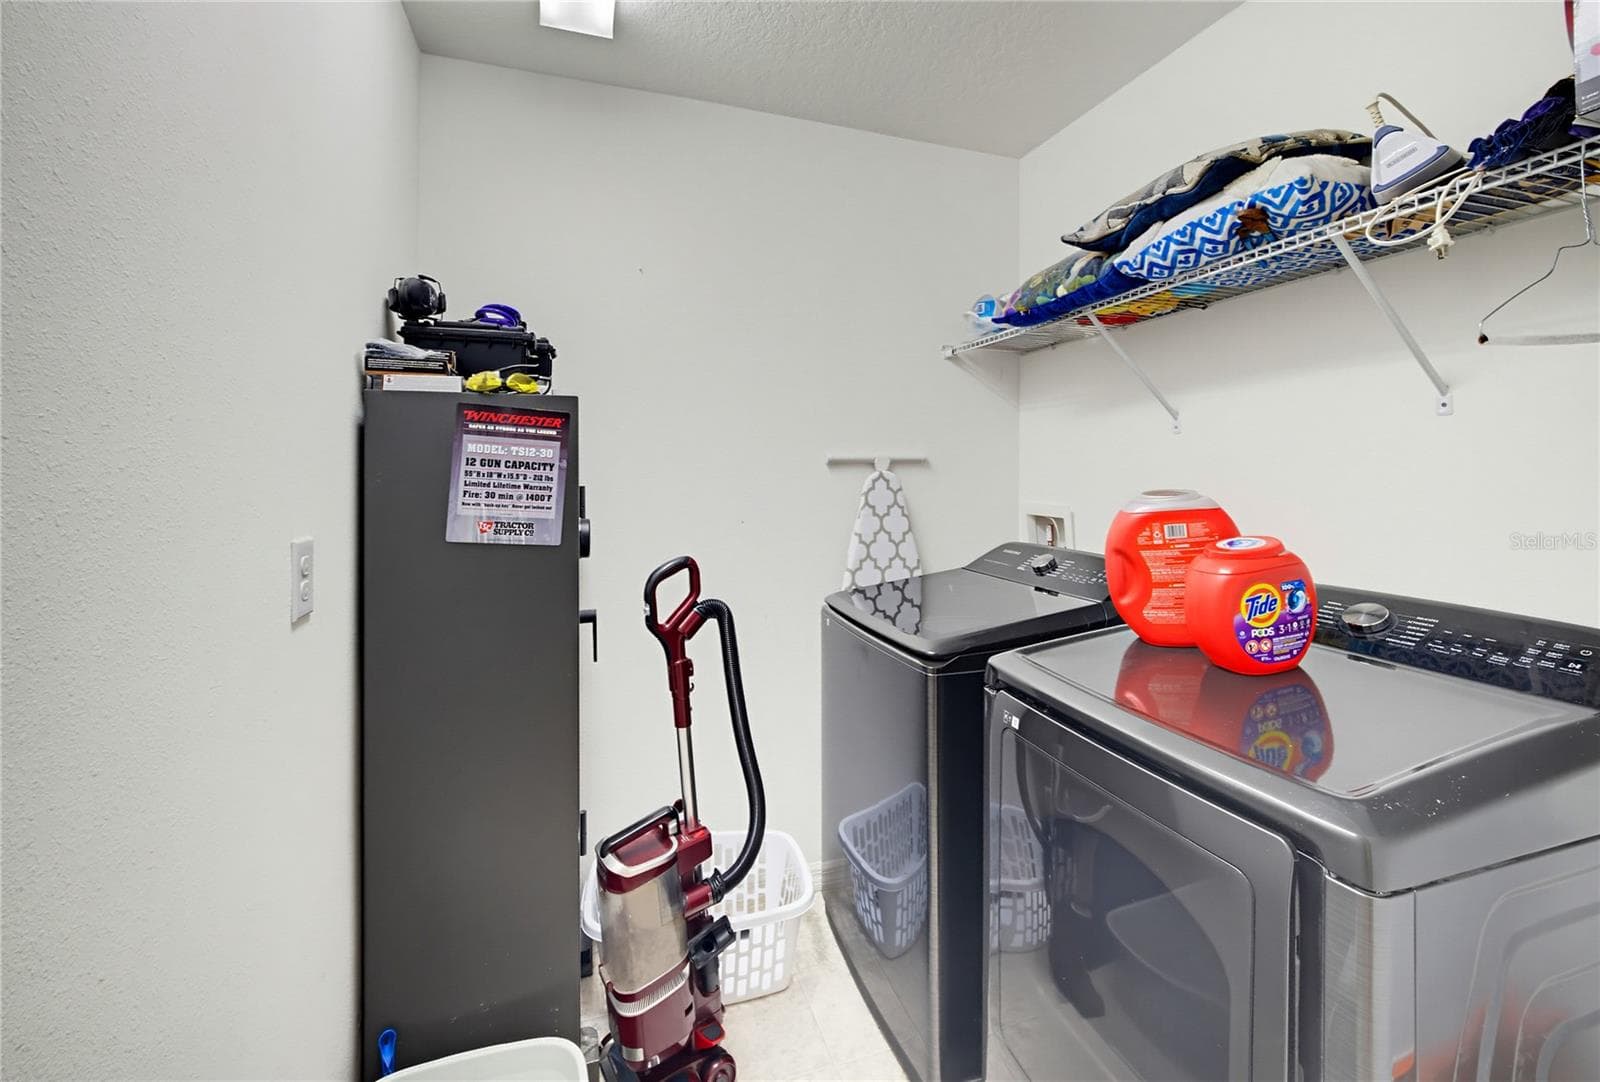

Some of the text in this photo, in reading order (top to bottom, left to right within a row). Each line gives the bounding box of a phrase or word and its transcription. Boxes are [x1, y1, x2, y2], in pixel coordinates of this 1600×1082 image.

[464, 410, 562, 428] WINCHESTER
[467, 444, 553, 458] MODEL: TS12-30
[465, 457, 555, 471] 12 GUN CAPACITY
[544, 474, 554, 482] lbs
[463, 480, 553, 493] Limited Lifetime Warranty
[462, 490, 482, 499] Fire:
[484, 491, 496, 499] 30
[497, 492, 514, 500] min
[516, 493, 524, 501] @
[494, 521, 534, 529] TRACTOR
[1245, 594, 1278, 622] Tide
[1251, 627, 1275, 638] PODS
